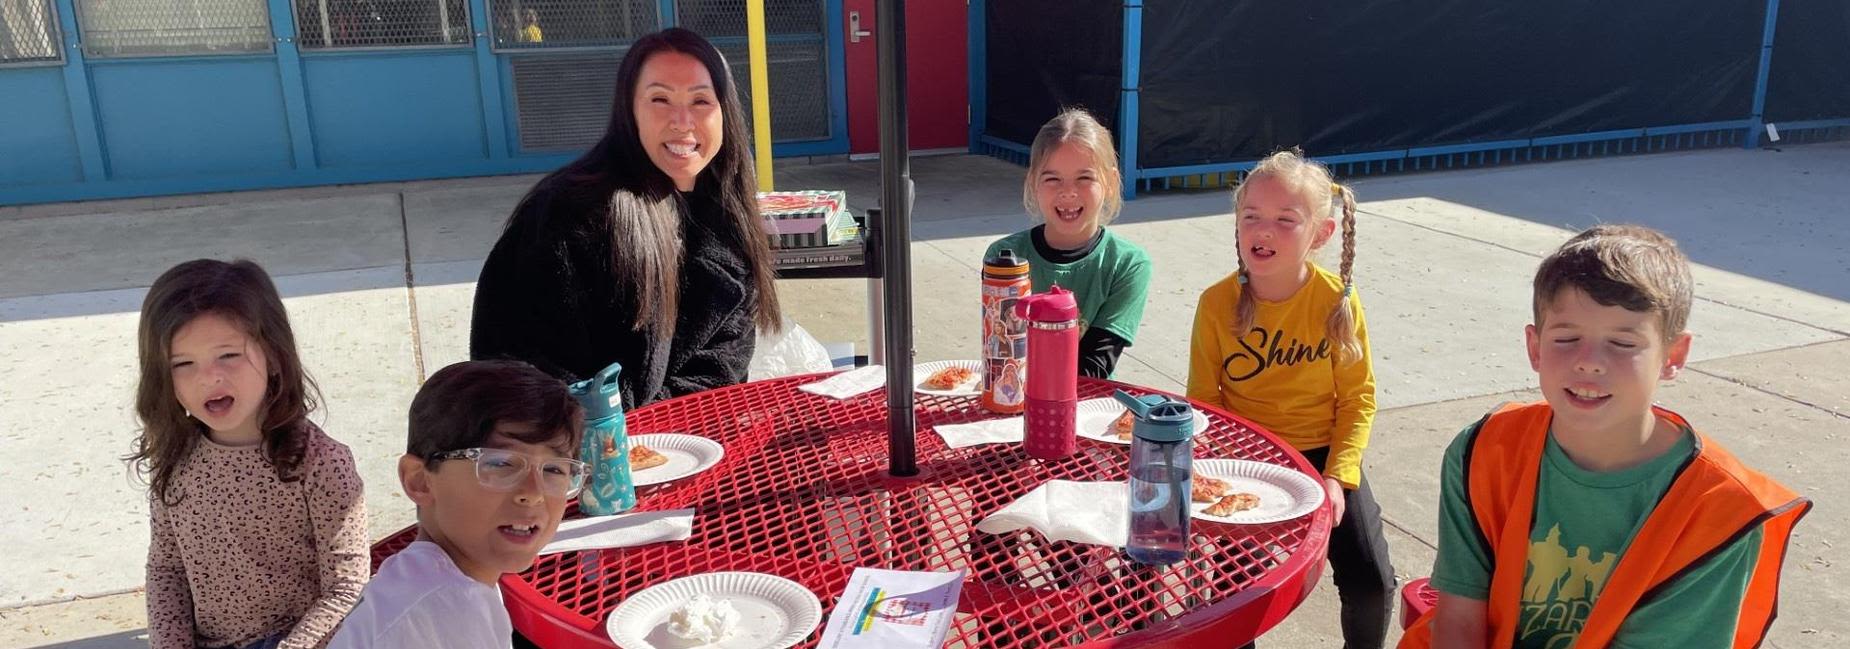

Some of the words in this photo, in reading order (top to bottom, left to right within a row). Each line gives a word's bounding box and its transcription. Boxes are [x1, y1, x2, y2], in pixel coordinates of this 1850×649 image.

[783, 256, 804, 264] made
[806, 255, 828, 263] fresh
[1223, 326, 1330, 382] Shine
[1520, 600, 1592, 640] ZAR
